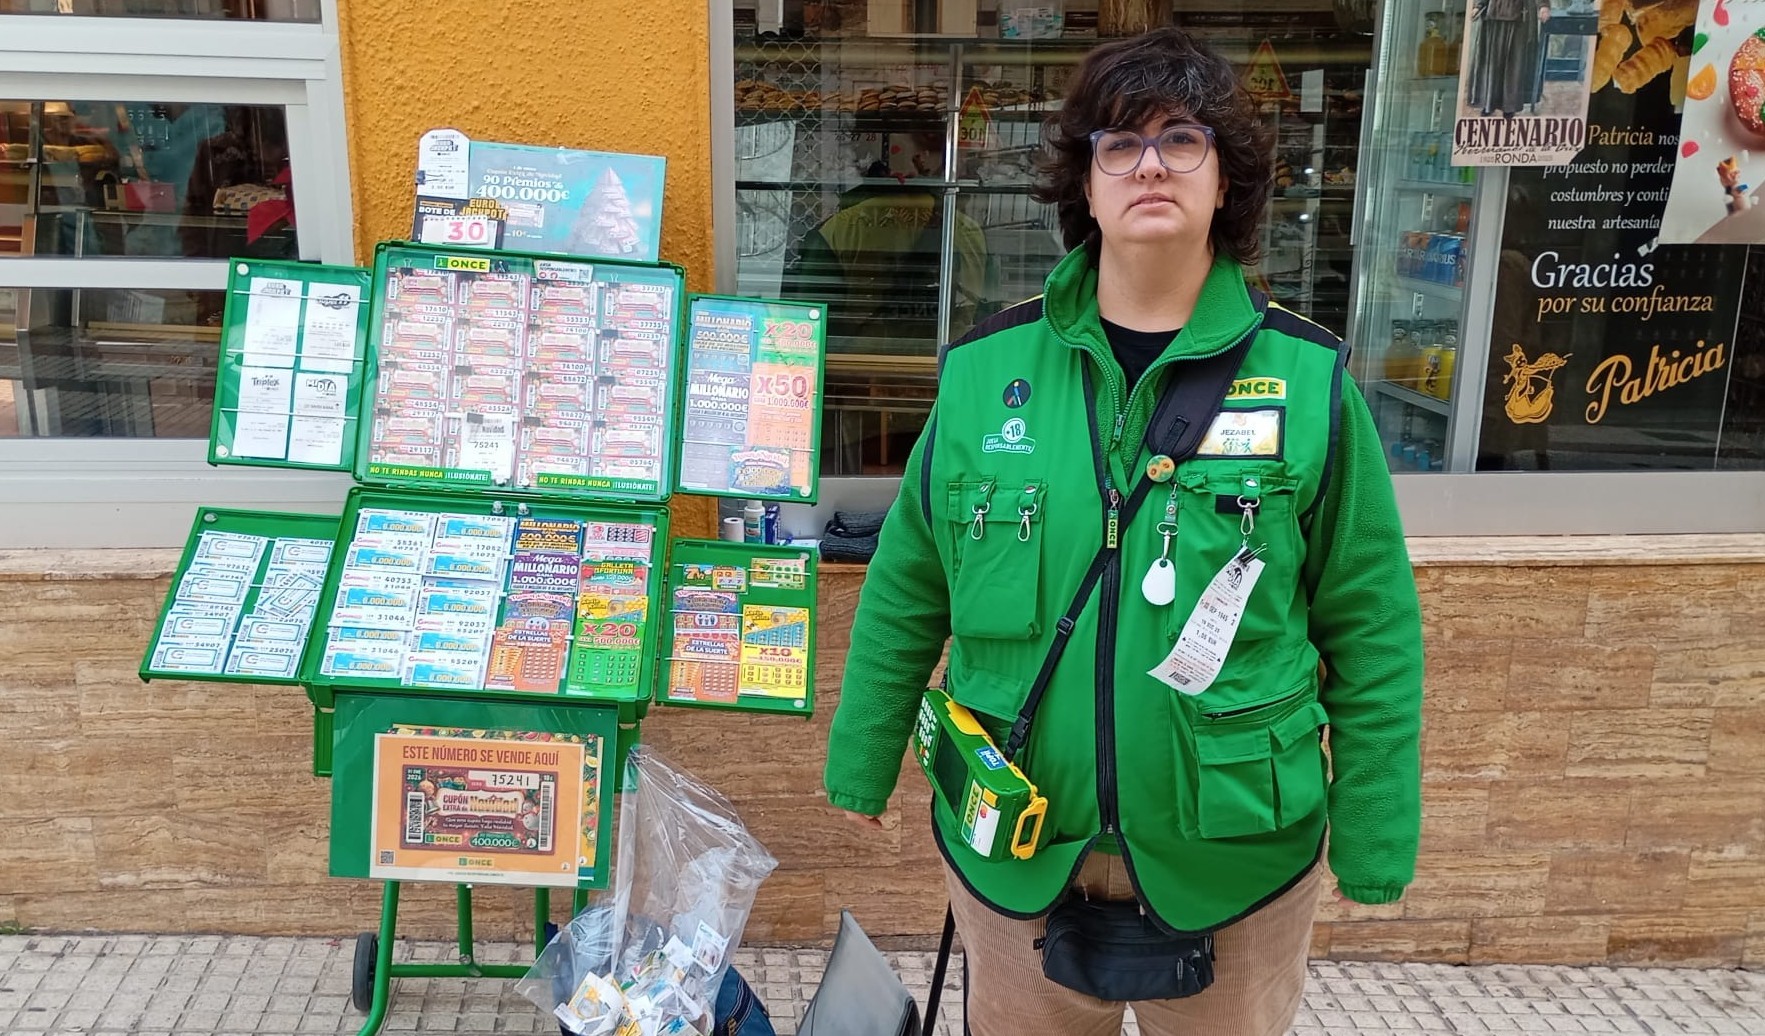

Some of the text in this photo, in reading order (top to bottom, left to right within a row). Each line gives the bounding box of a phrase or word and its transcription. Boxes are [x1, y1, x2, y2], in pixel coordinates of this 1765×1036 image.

[1455, 117, 1584, 148] CENTENARIO
[1587, 124, 1655, 146] Patricia
[1494, 152, 1537, 164] RONDA
[1611, 163, 1629, 175] no
[483, 174, 500, 185] 90
[502, 175, 552, 190] Premios
[475, 185, 570, 203] 400.000€
[1549, 183, 1624, 202] costumbres
[1625, 191, 1636, 207] y
[418, 205, 443, 215] BOTE
[443, 207, 456, 216] DE
[1547, 214, 1597, 230] nuestra
[447, 221, 485, 241] 30
[450, 259, 487, 269] ONCE
[1530, 250, 1656, 289] Gracias
[1536, 284, 1715, 323] por su confianza
[695, 316, 752, 328] MILLONARIO
[695, 331, 749, 344] 500.000€
[707, 372, 736, 386] Mega
[1584, 338, 1727, 425] Patricia
[690, 384, 749, 400] MILLONARIO
[690, 399, 749, 413] 1.000.000€
[1220, 428, 1257, 437] JEZABEL
[473, 440, 499, 450] 75241
[369, 466, 380, 475] NO
[381, 466, 389, 475] TE
[391, 467, 417, 477] RINDAS
[419, 469, 443, 479] NUNCA
[538, 476, 549, 484] NO
[560, 478, 586, 487] RINDAS
[587, 479, 611, 488] NUNCA
[519, 532, 577, 544] 500.000€
[1109, 520, 1117, 546] ONCE
[532, 553, 565, 566] Mega
[513, 562, 579, 575] MILLONARIO
[512, 575, 578, 587] 1.000.000€
[513, 629, 548, 637] ESTRELLAS
[527, 636, 552, 644] SUERTE
[689, 638, 726, 648] ESTRELLAS
[685, 645, 697, 653] DE
[705, 646, 729, 655] SUERTE
[402, 743, 560, 766] ESTE NÚMERO SE VENDE AQUÍ
[491, 773, 530, 787] 75241
[442, 793, 468, 805] CUPÓN
[442, 804, 461, 812] EXTRA
[469, 795, 518, 815] Navidad
[965, 784, 982, 826] ONCE
[470, 837, 520, 848] 400.000€
[467, 858, 493, 867] ONCE
